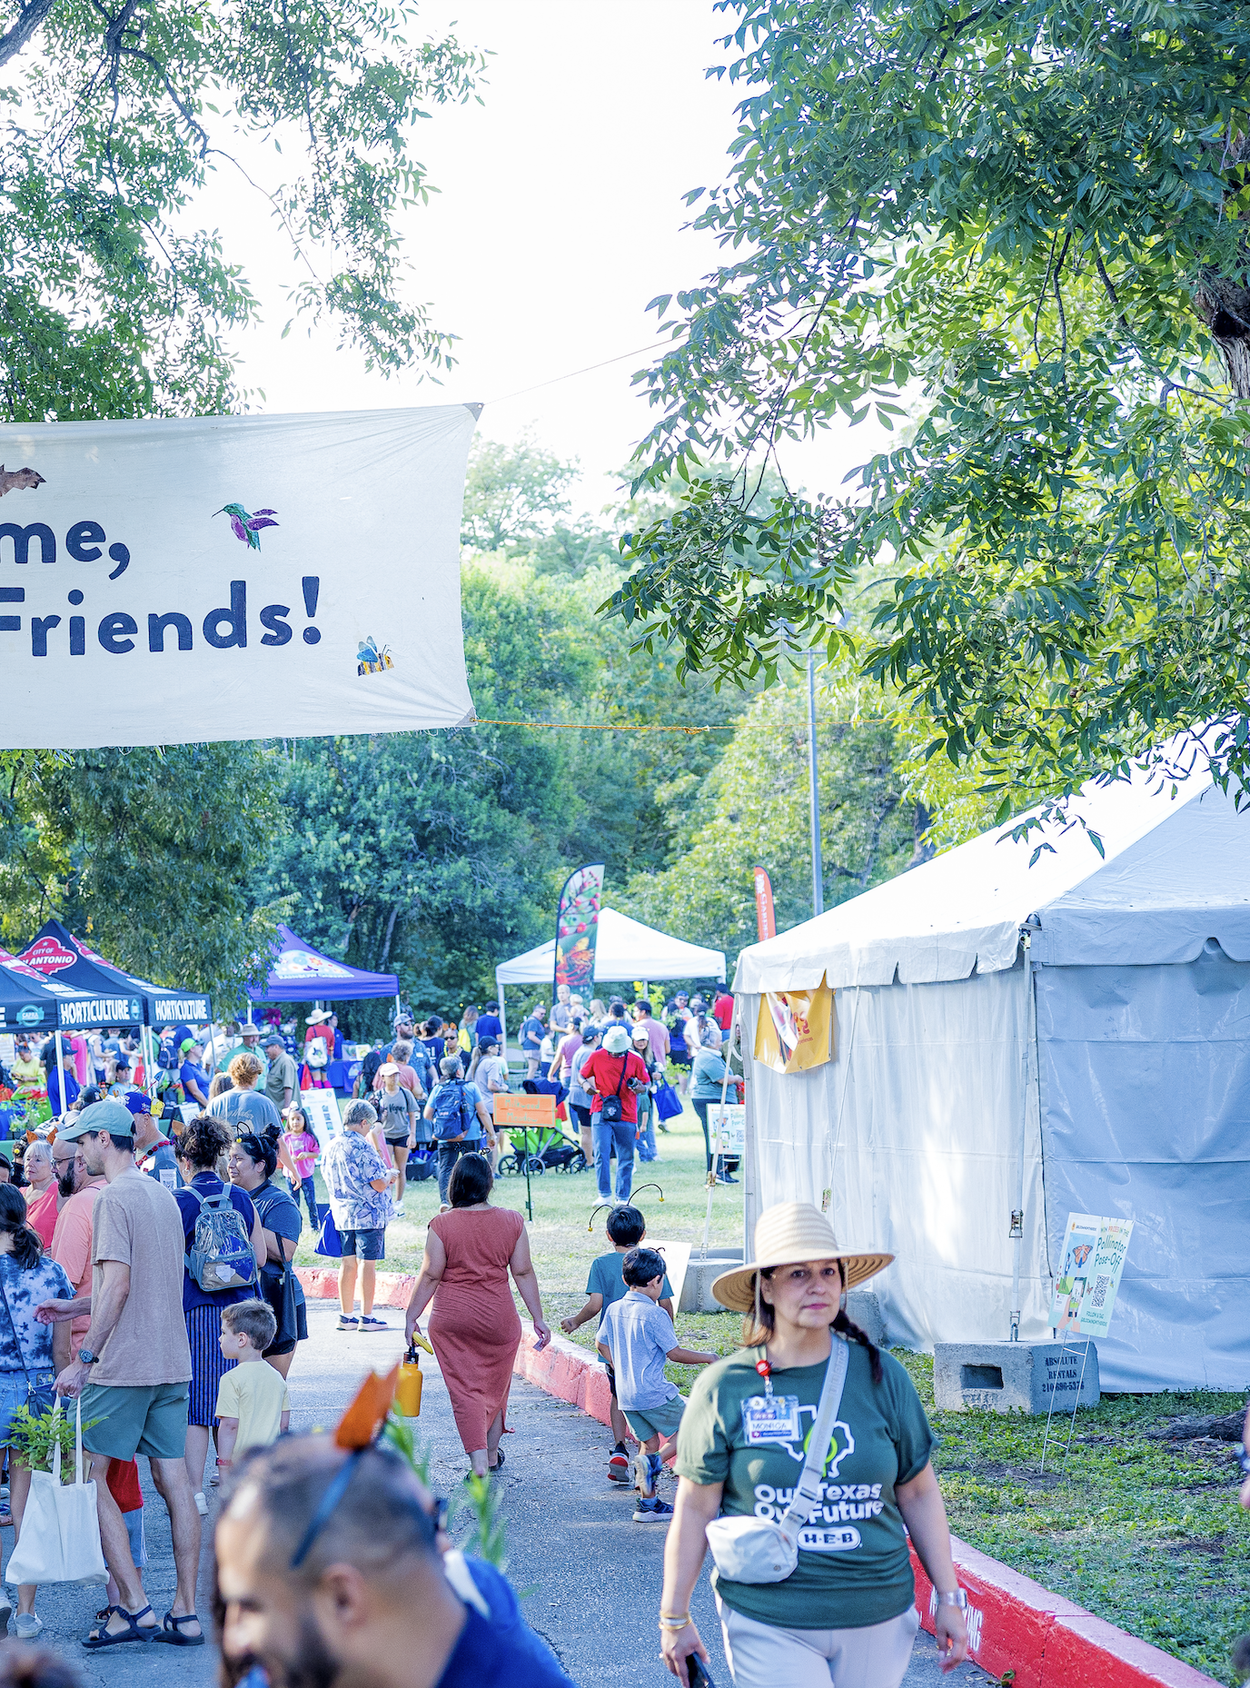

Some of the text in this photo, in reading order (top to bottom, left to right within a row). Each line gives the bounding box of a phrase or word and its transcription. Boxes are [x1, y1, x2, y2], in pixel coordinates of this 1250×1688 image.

[29, 956, 73, 966] ANTONIO
[60, 999, 131, 1025] HORTICULTURE
[155, 1000, 208, 1021] HORTICULTURE
[1096, 1235, 1127, 1254] Pollinator
[1094, 1252, 1123, 1274] Pose-Off
[1044, 1356, 1078, 1367] ABSOLUTE
[1048, 1369, 1077, 1380] RENTALS
[817, 1482, 883, 1501] Texas
[808, 1499, 885, 1525] Future
